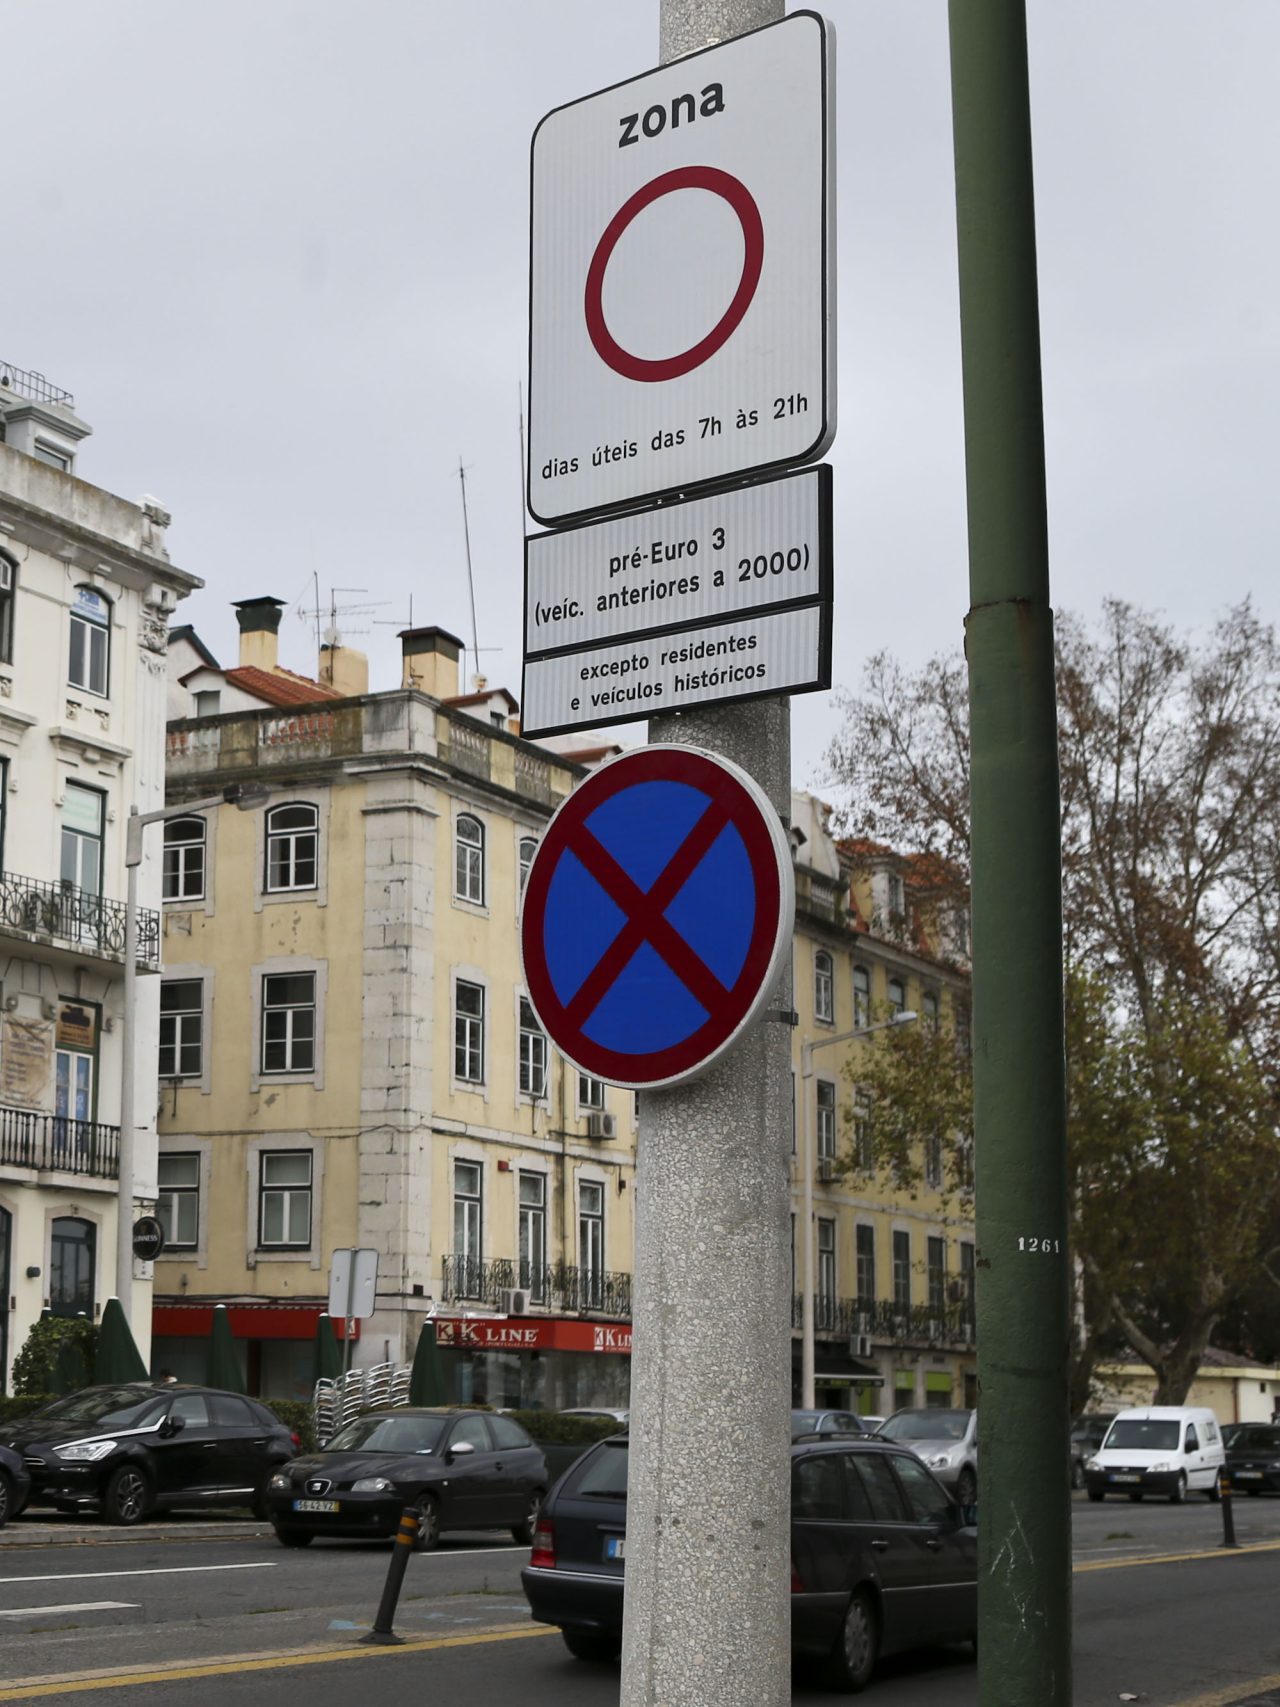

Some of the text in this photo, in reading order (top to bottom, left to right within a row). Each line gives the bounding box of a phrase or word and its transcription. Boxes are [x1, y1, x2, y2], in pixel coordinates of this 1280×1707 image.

[619, 82, 726, 149] zona
[542, 393, 808, 479] dias úteis das 7h às 21h
[609, 527, 726, 577] pré-Euro 3
[535, 543, 810, 627] (veíc. anteriores a 2000)
[580, 634, 757, 681] excepto residentes
[571, 663, 766, 711] e veículos históricos
[1018, 1236, 1059, 1254] 1261
[486, 1327, 539, 1343] LINE
